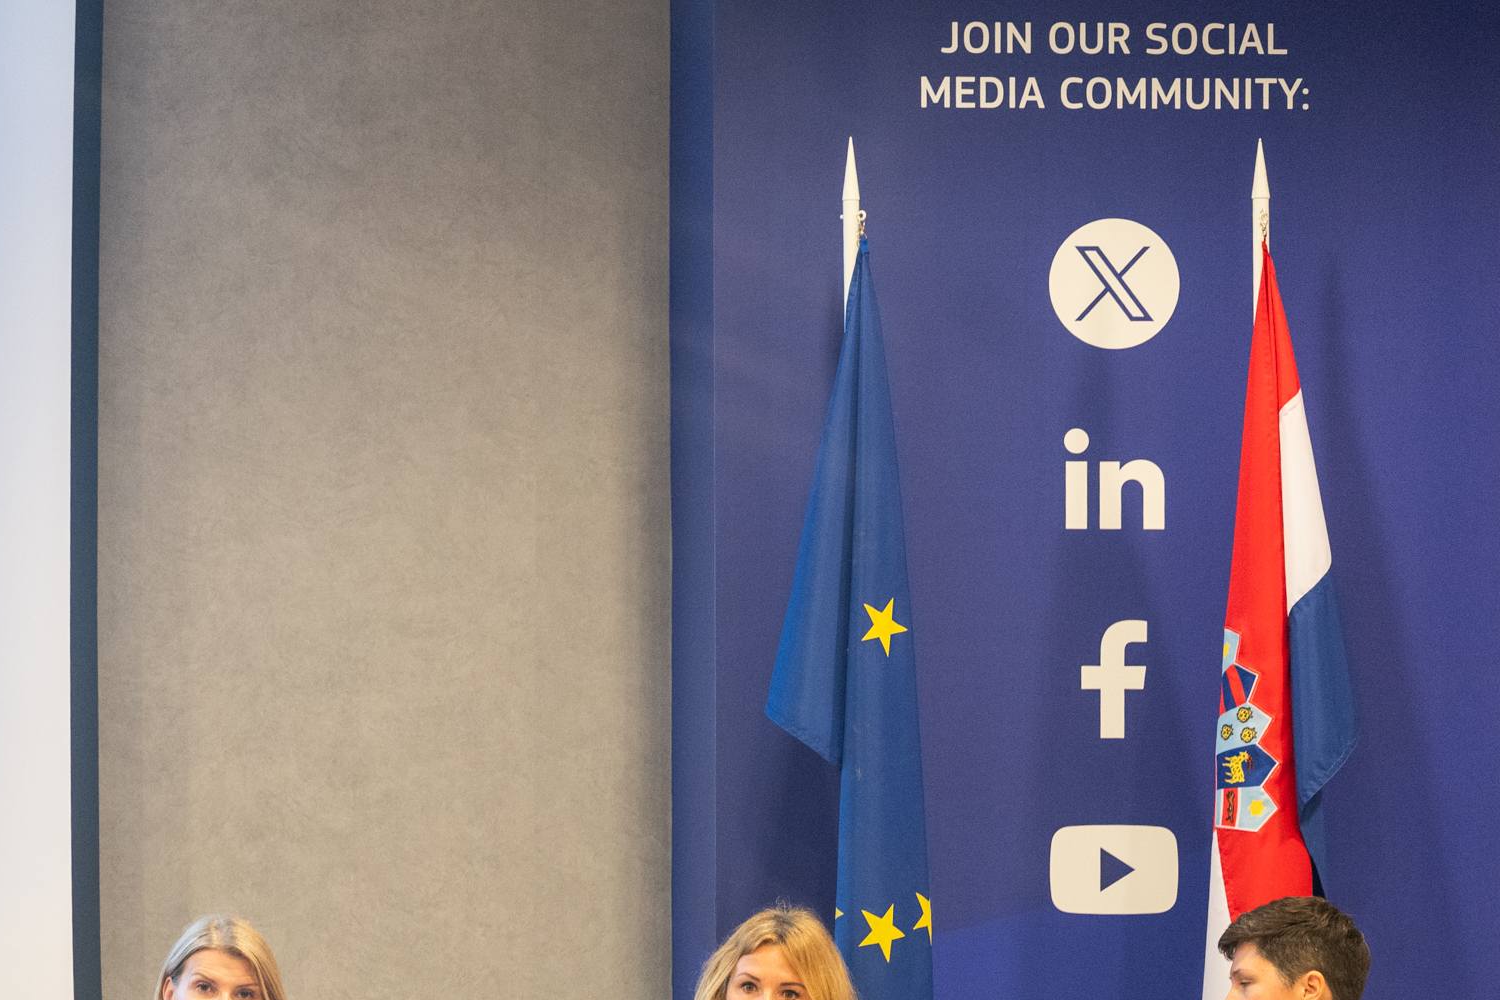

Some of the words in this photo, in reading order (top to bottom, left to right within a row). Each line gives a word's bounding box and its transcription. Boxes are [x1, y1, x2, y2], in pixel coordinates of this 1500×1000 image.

[941, 21, 1031, 54] JOIN
[1049, 22, 1130, 54] OUR
[1146, 23, 1287, 55] SOCIAL
[921, 76, 1045, 108] MEDIA
[1061, 77, 1309, 110] COMMUNITY:
[1064, 428, 1165, 530] in
